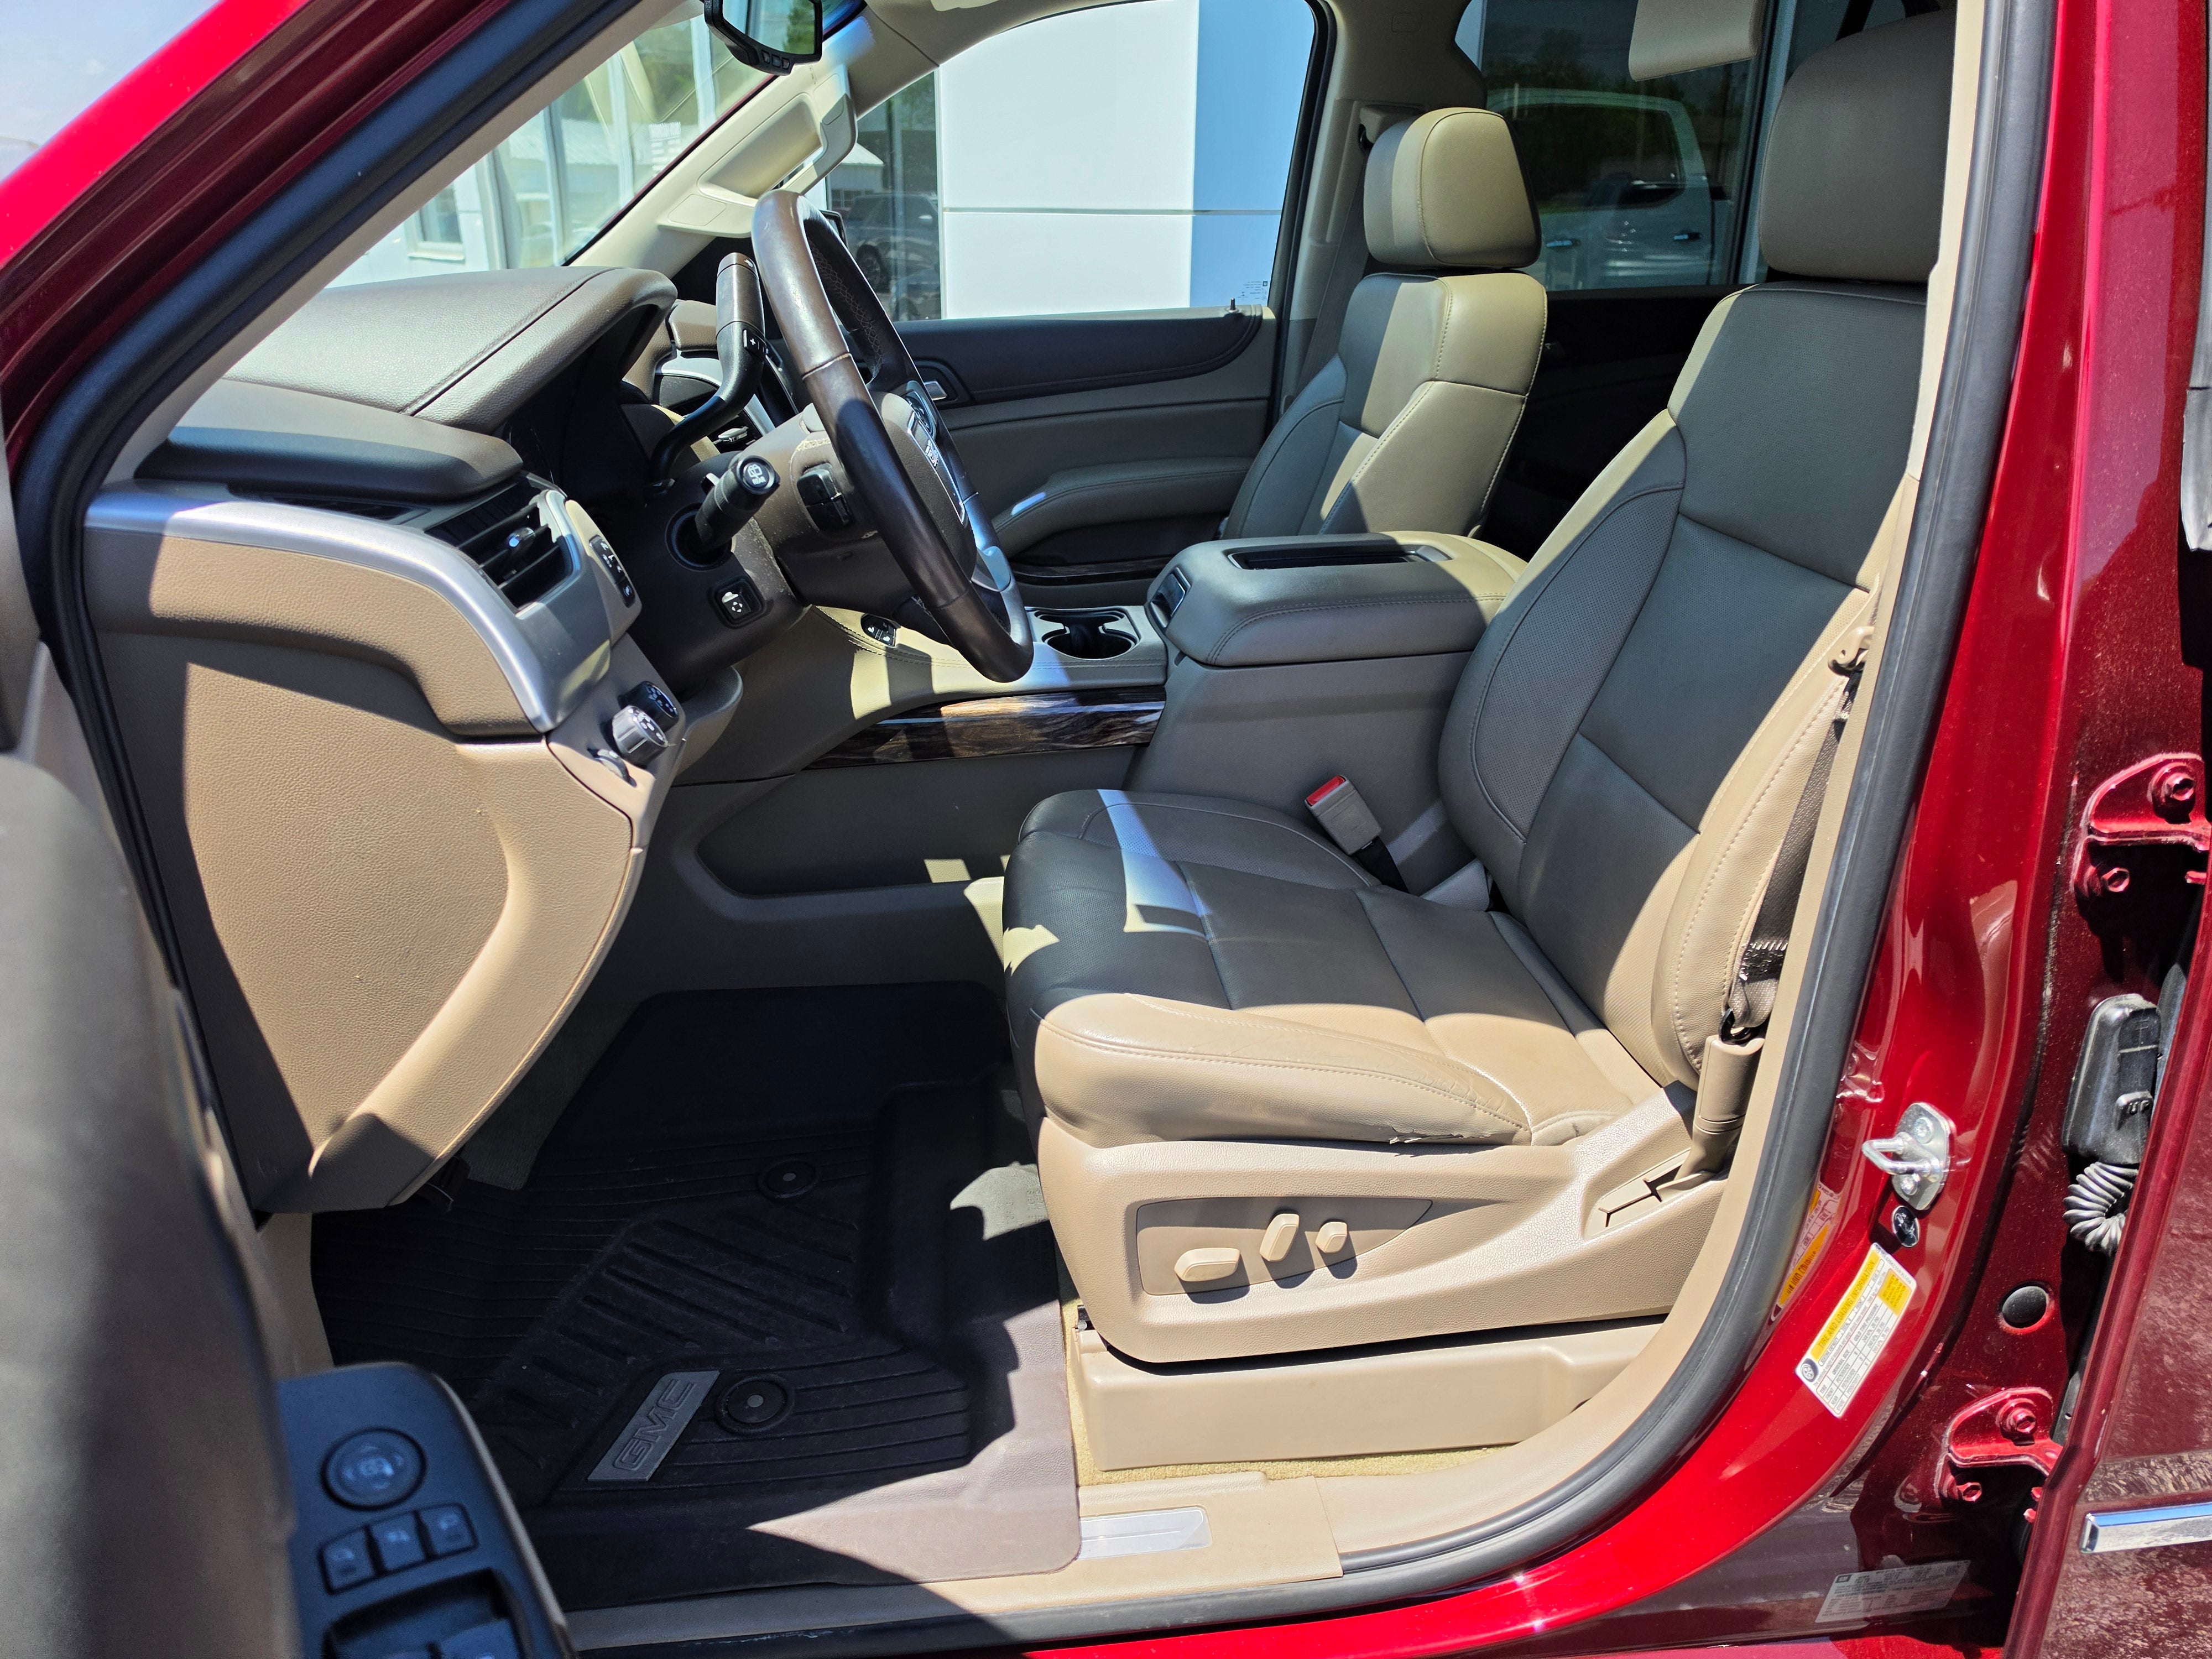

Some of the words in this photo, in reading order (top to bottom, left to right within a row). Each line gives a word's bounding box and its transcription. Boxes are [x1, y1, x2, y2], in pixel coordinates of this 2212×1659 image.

[752, 476, 766, 485] REAR
[2129, 1099, 2150, 1115] UP
[1818, 1334, 1829, 1349] TIRE
[1827, 1322, 1837, 1337] AND
[1835, 1297, 1853, 1324] LOADING
[1850, 1259, 1876, 1300] INFORMATION
[1853, 1330, 1861, 1342] COLD
[1865, 1303, 1879, 1323] PRESSURE
[1832, 1357, 1844, 1376] ORIGINAL
[612, 1379, 696, 1472] GMC
